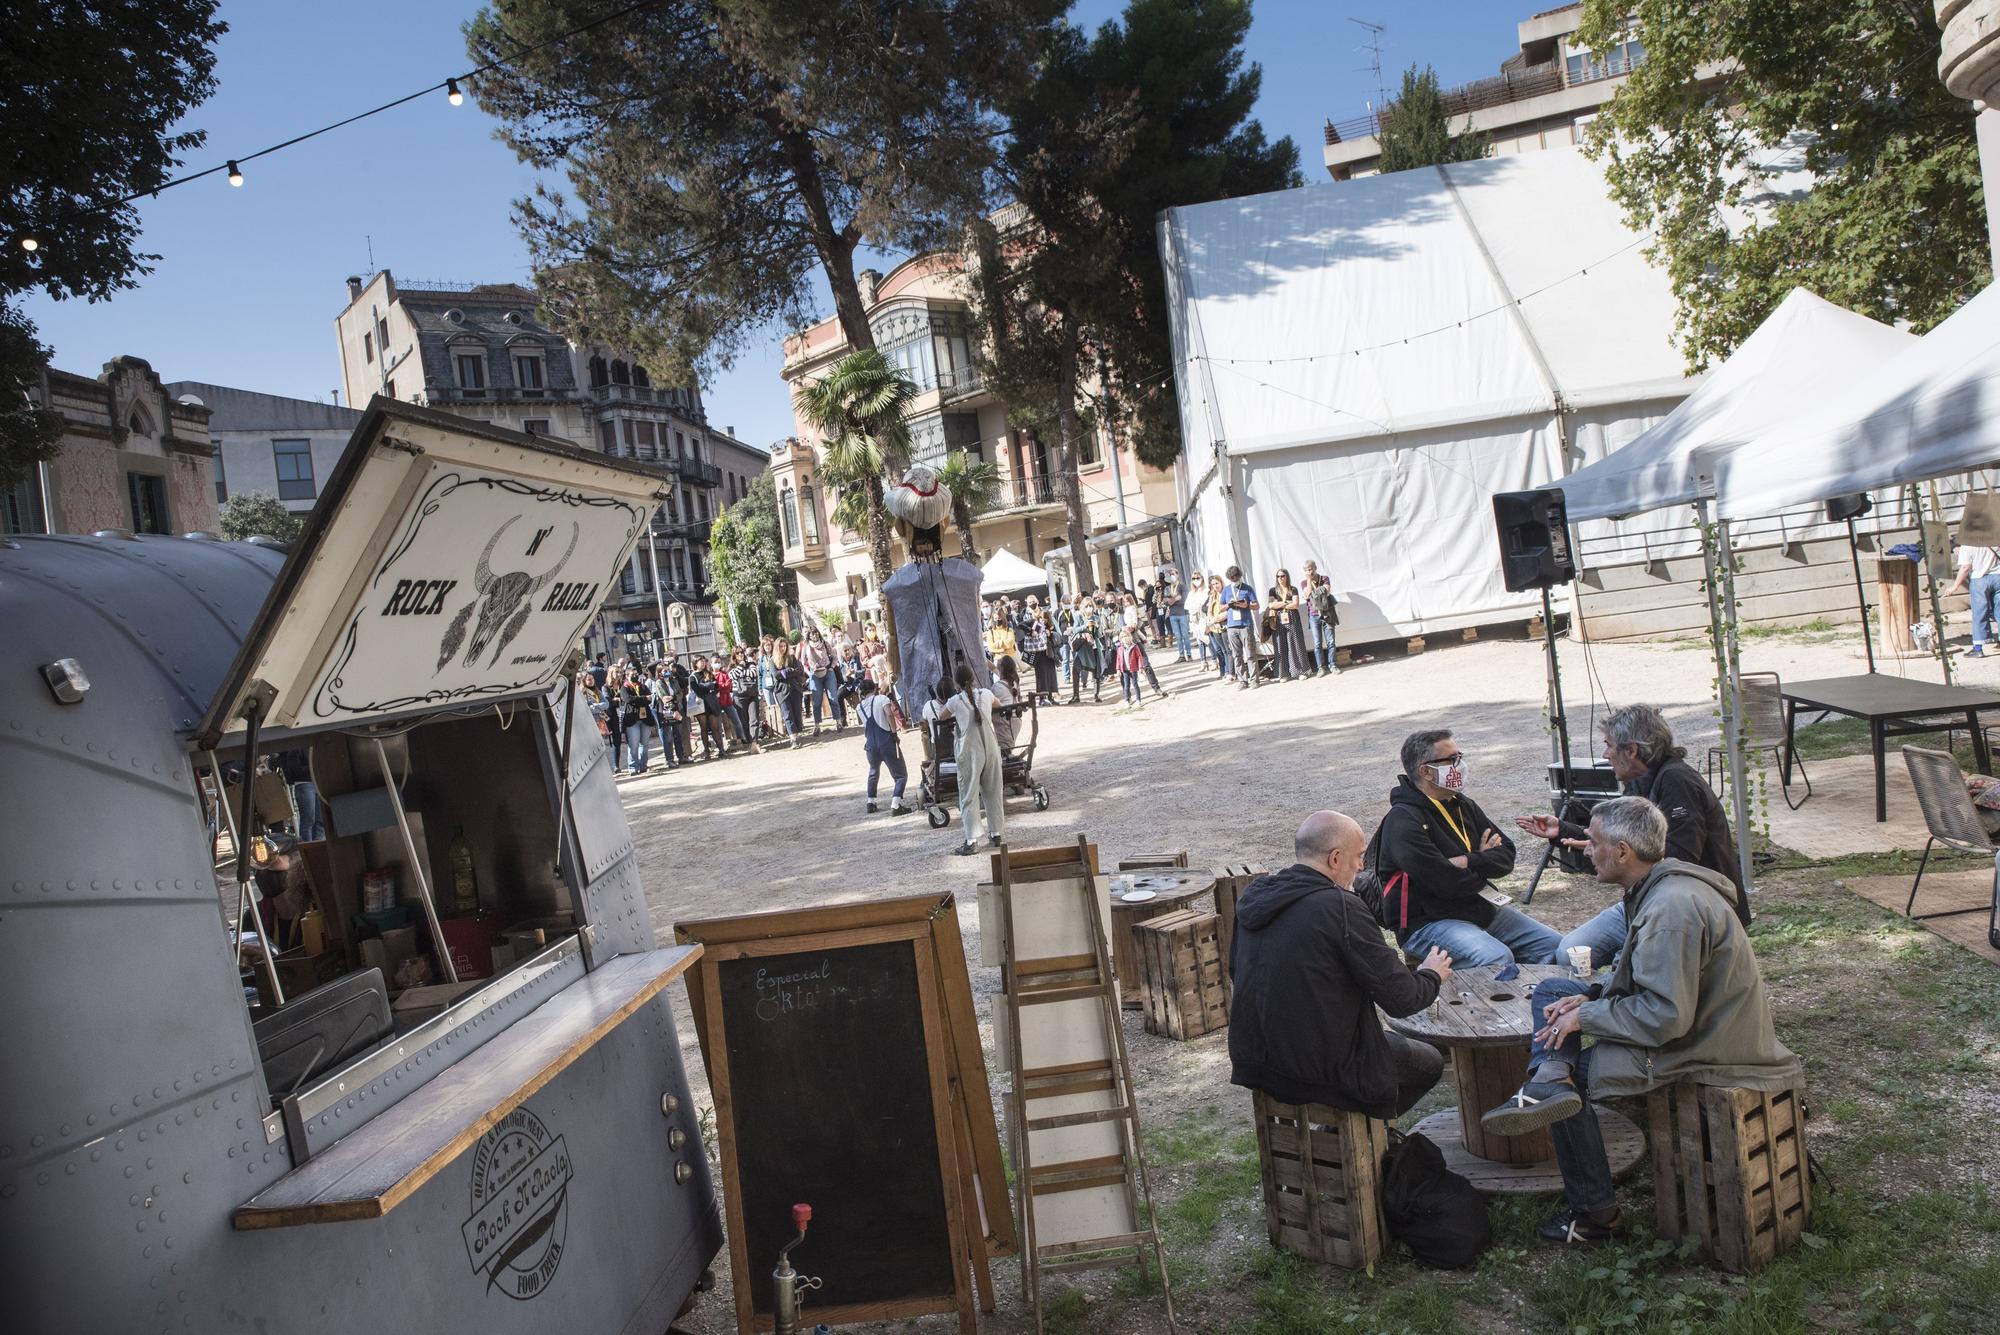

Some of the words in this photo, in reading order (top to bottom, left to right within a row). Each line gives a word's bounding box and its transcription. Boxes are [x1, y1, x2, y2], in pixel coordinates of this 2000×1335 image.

[525, 525, 554, 556] N'
[381, 579, 458, 616] ROCK
[541, 582, 599, 612] RAOLA
[1445, 780, 1463, 788] RER
[1446, 772, 1462, 781] CAR
[756, 960, 831, 997] Especial
[474, 1139, 490, 1199] QUALITY
[487, 1129, 496, 1145] &
[527, 1116, 544, 1142] MEAT
[474, 1200, 510, 1254] Rock
[517, 1271, 540, 1294] FOOD
[539, 1240, 561, 1281] TRUCK
